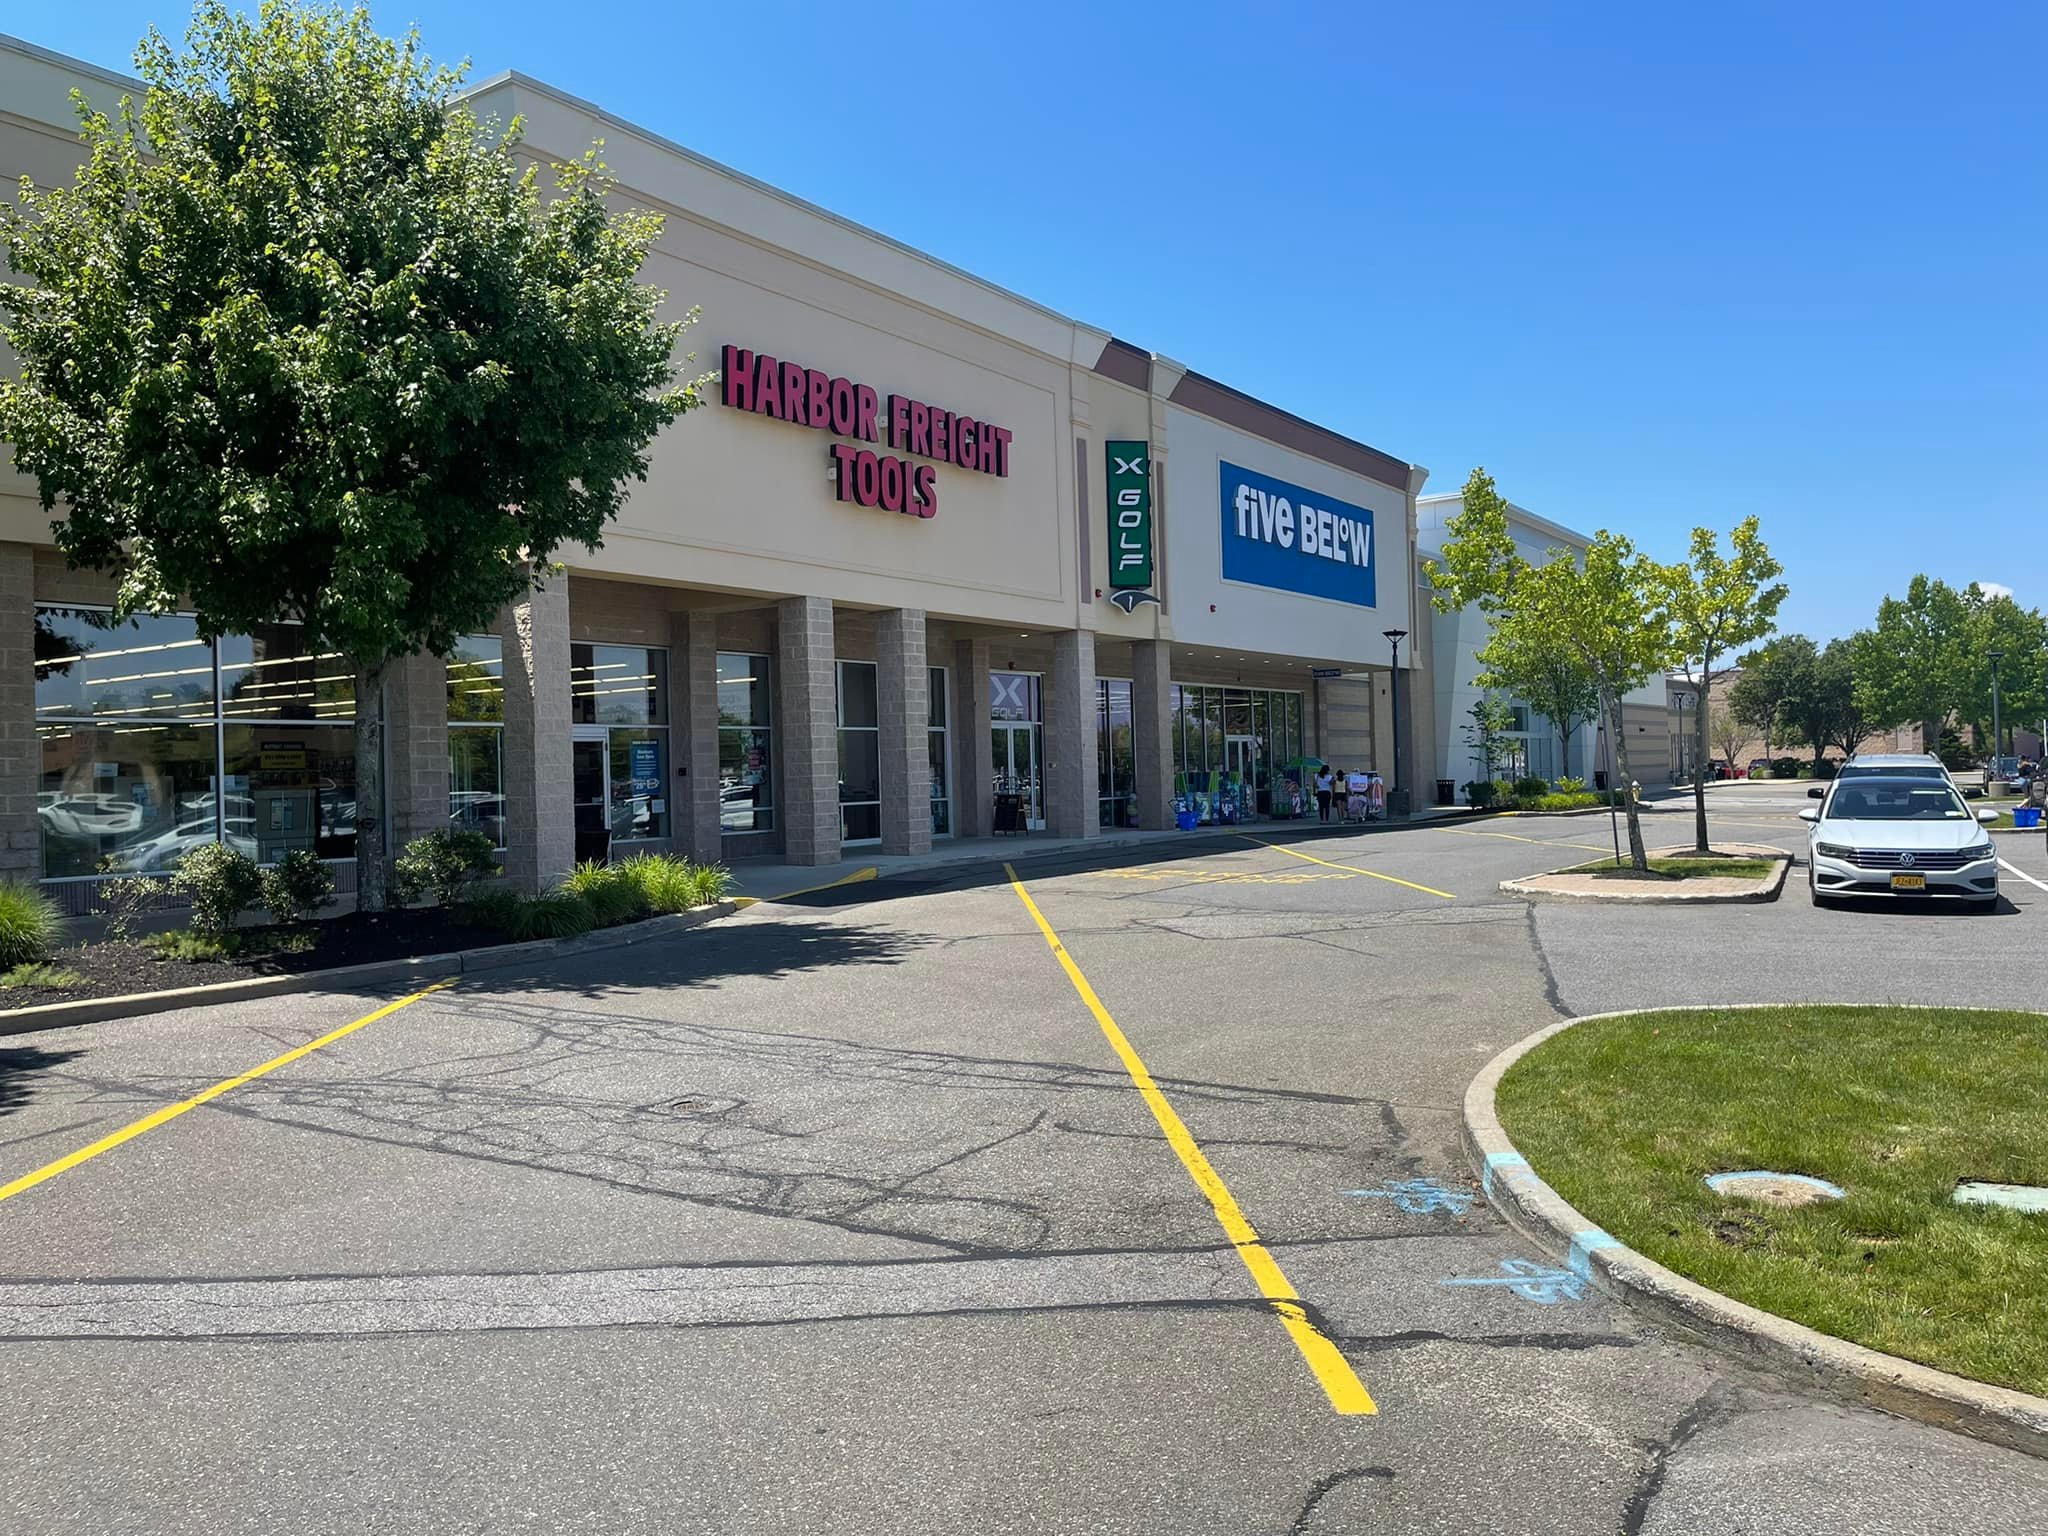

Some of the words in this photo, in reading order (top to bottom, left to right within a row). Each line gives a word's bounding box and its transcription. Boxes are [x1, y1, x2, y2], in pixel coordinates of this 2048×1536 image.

[721, 345, 879, 443] HARBOR
[887, 393, 1013, 478] FREIGHT
[830, 444, 938, 519] TOOLS
[1113, 457, 1144, 475] X
[1116, 488, 1145, 571] GOLF
[1299, 504, 1371, 568] BELOW
[990, 675, 1022, 706] X
[991, 706, 1025, 720] GOLF
